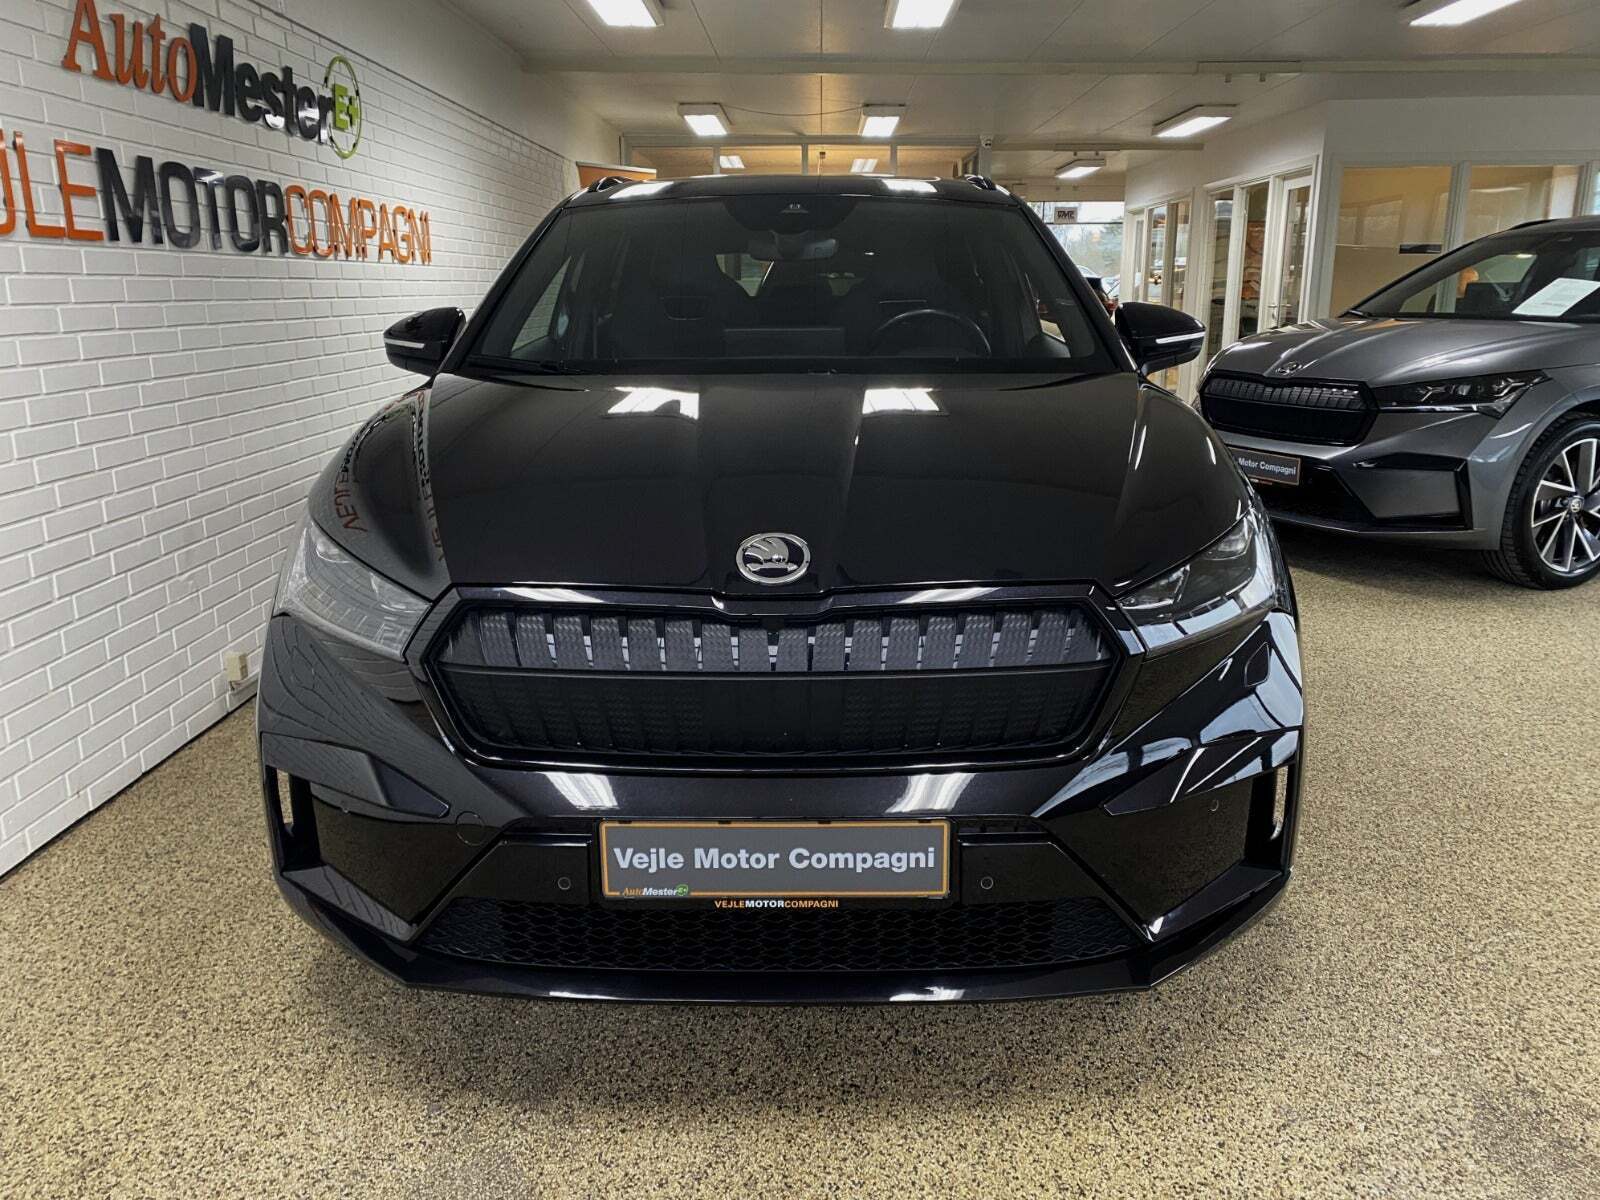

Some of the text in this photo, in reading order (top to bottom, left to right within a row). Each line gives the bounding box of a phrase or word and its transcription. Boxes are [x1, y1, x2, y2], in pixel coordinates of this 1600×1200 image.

[1239, 457, 1296, 475] Motor Compagni
[613, 847, 936, 873] Vejle Motor Compagni
